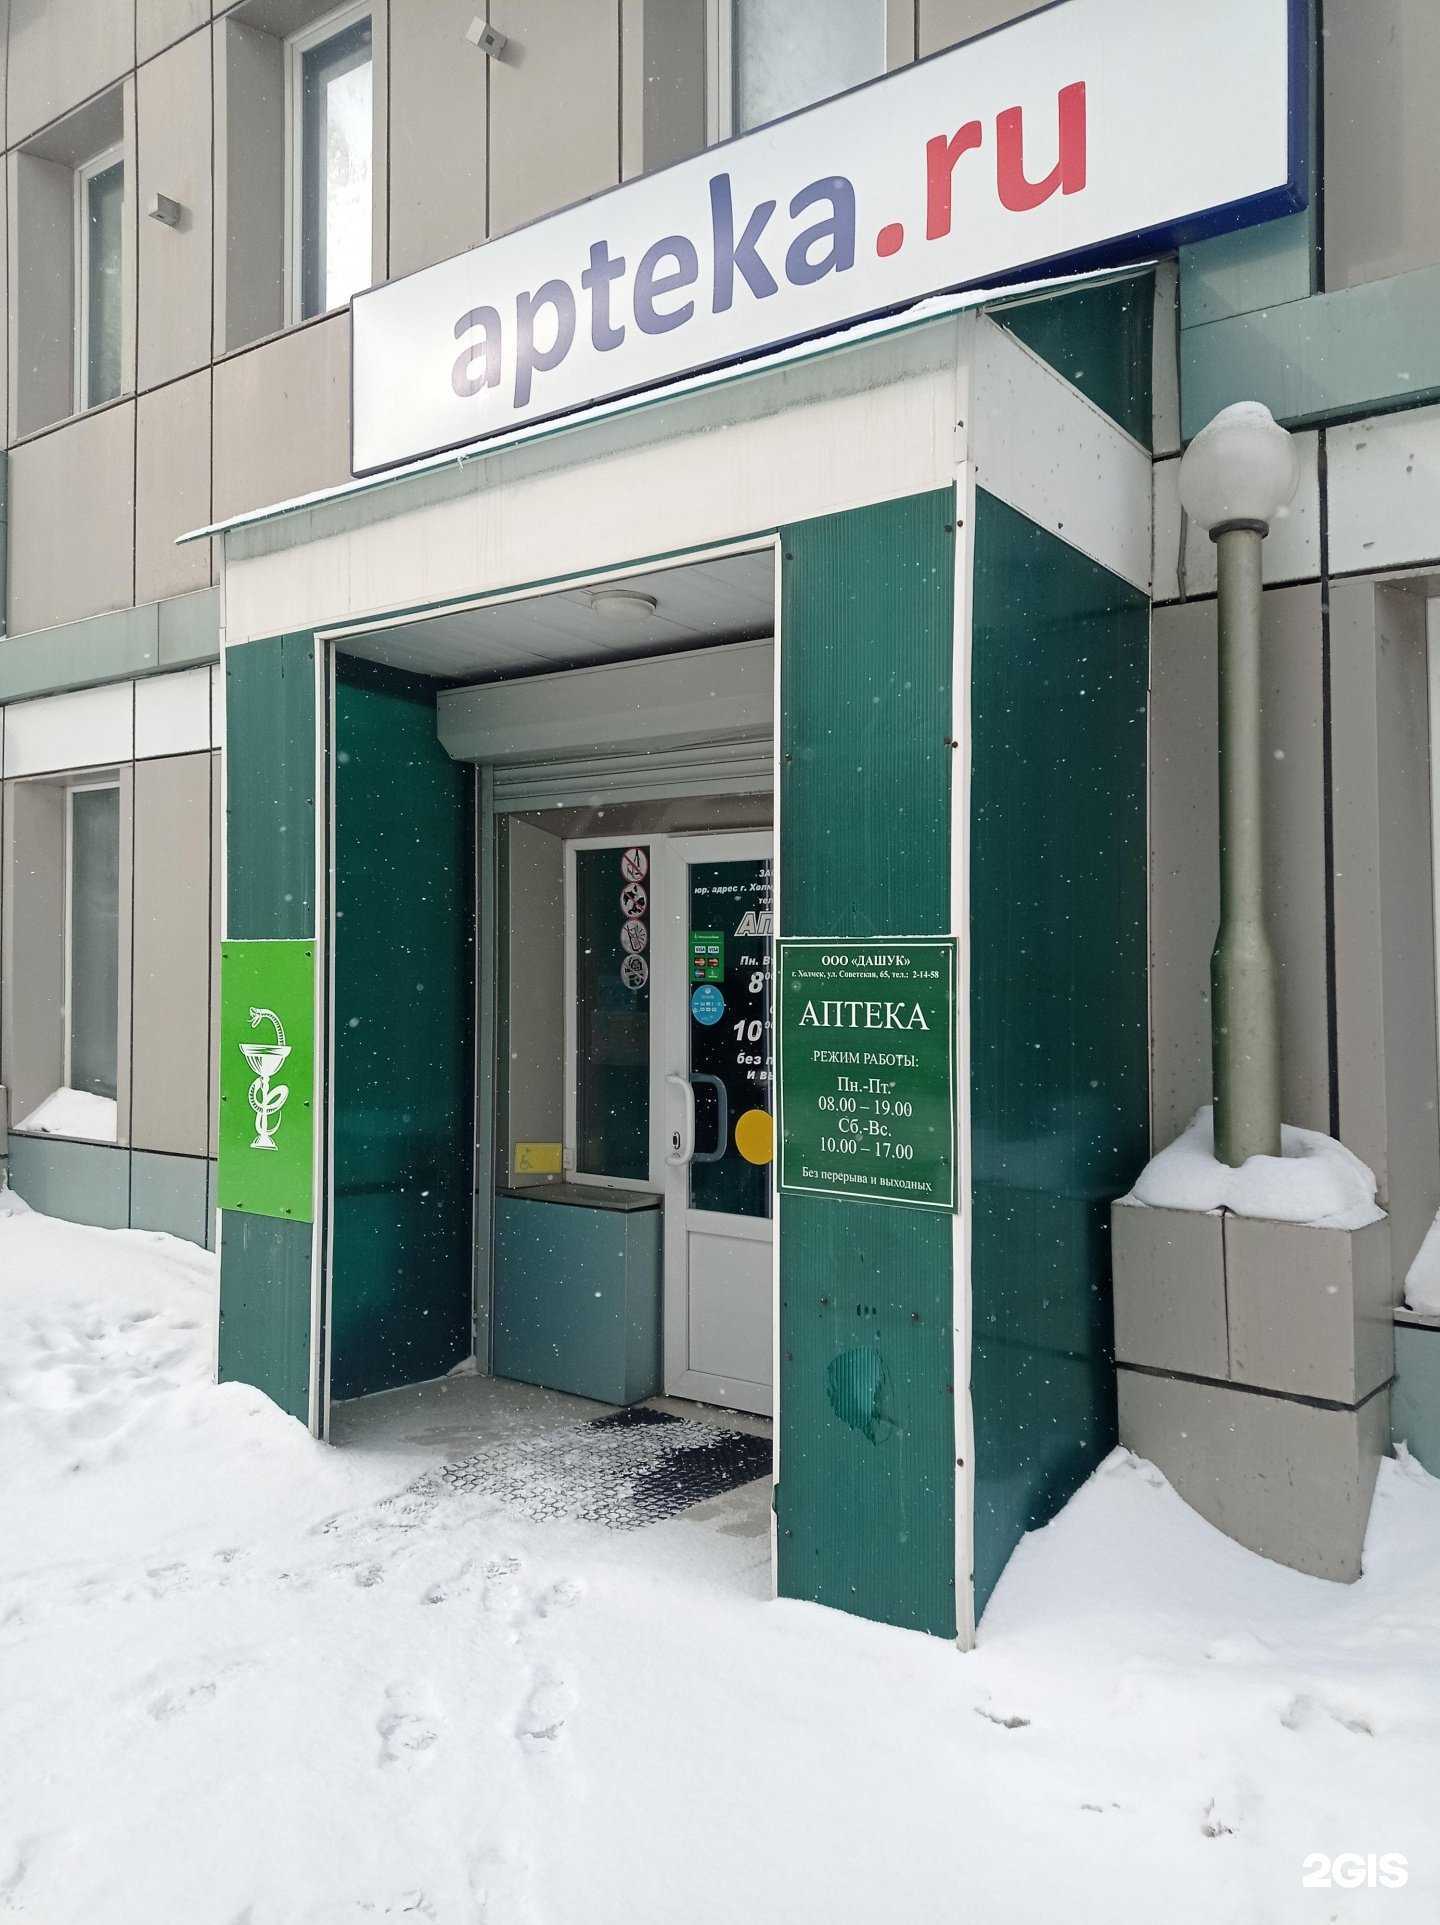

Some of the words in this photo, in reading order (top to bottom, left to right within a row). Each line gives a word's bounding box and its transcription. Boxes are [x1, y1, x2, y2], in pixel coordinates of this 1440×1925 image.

[451, 80, 1088, 408] apteka.ru
[694, 887, 710, 895] юр.
[711, 884, 738, 895] адрес
[733, 911, 774, 937] АП
[740, 956, 759, 966] Пн.
[821, 955, 849, 966] ООО
[851, 955, 911, 967] «ДАШУК»
[827, 971, 838, 979] ул.
[839, 970, 879, 979] Советская,
[879, 970, 891, 979] 65,
[912, 970, 940, 978] 2-14-58
[799, 1000, 930, 1030] АПТЕКА
[736, 1052, 762, 1065] без
[813, 1050, 860, 1064] РЕЖИМ
[863, 1052, 919, 1068] РАБОТЫ:
[837, 1076, 891, 1094] Пн.-Пт.
[818, 1096, 857, 1113] 08.00
[875, 1100, 913, 1117] 19.00
[838, 1118, 892, 1137] Сб.-Вс.
[820, 1136, 857, 1154] 10.00
[875, 1142, 913, 1160] 17.00
[802, 1166, 818, 1178] Без
[821, 1170, 868, 1184] перерыва
[870, 1176, 877, 1185] и
[880, 1177, 933, 1191] выходных
